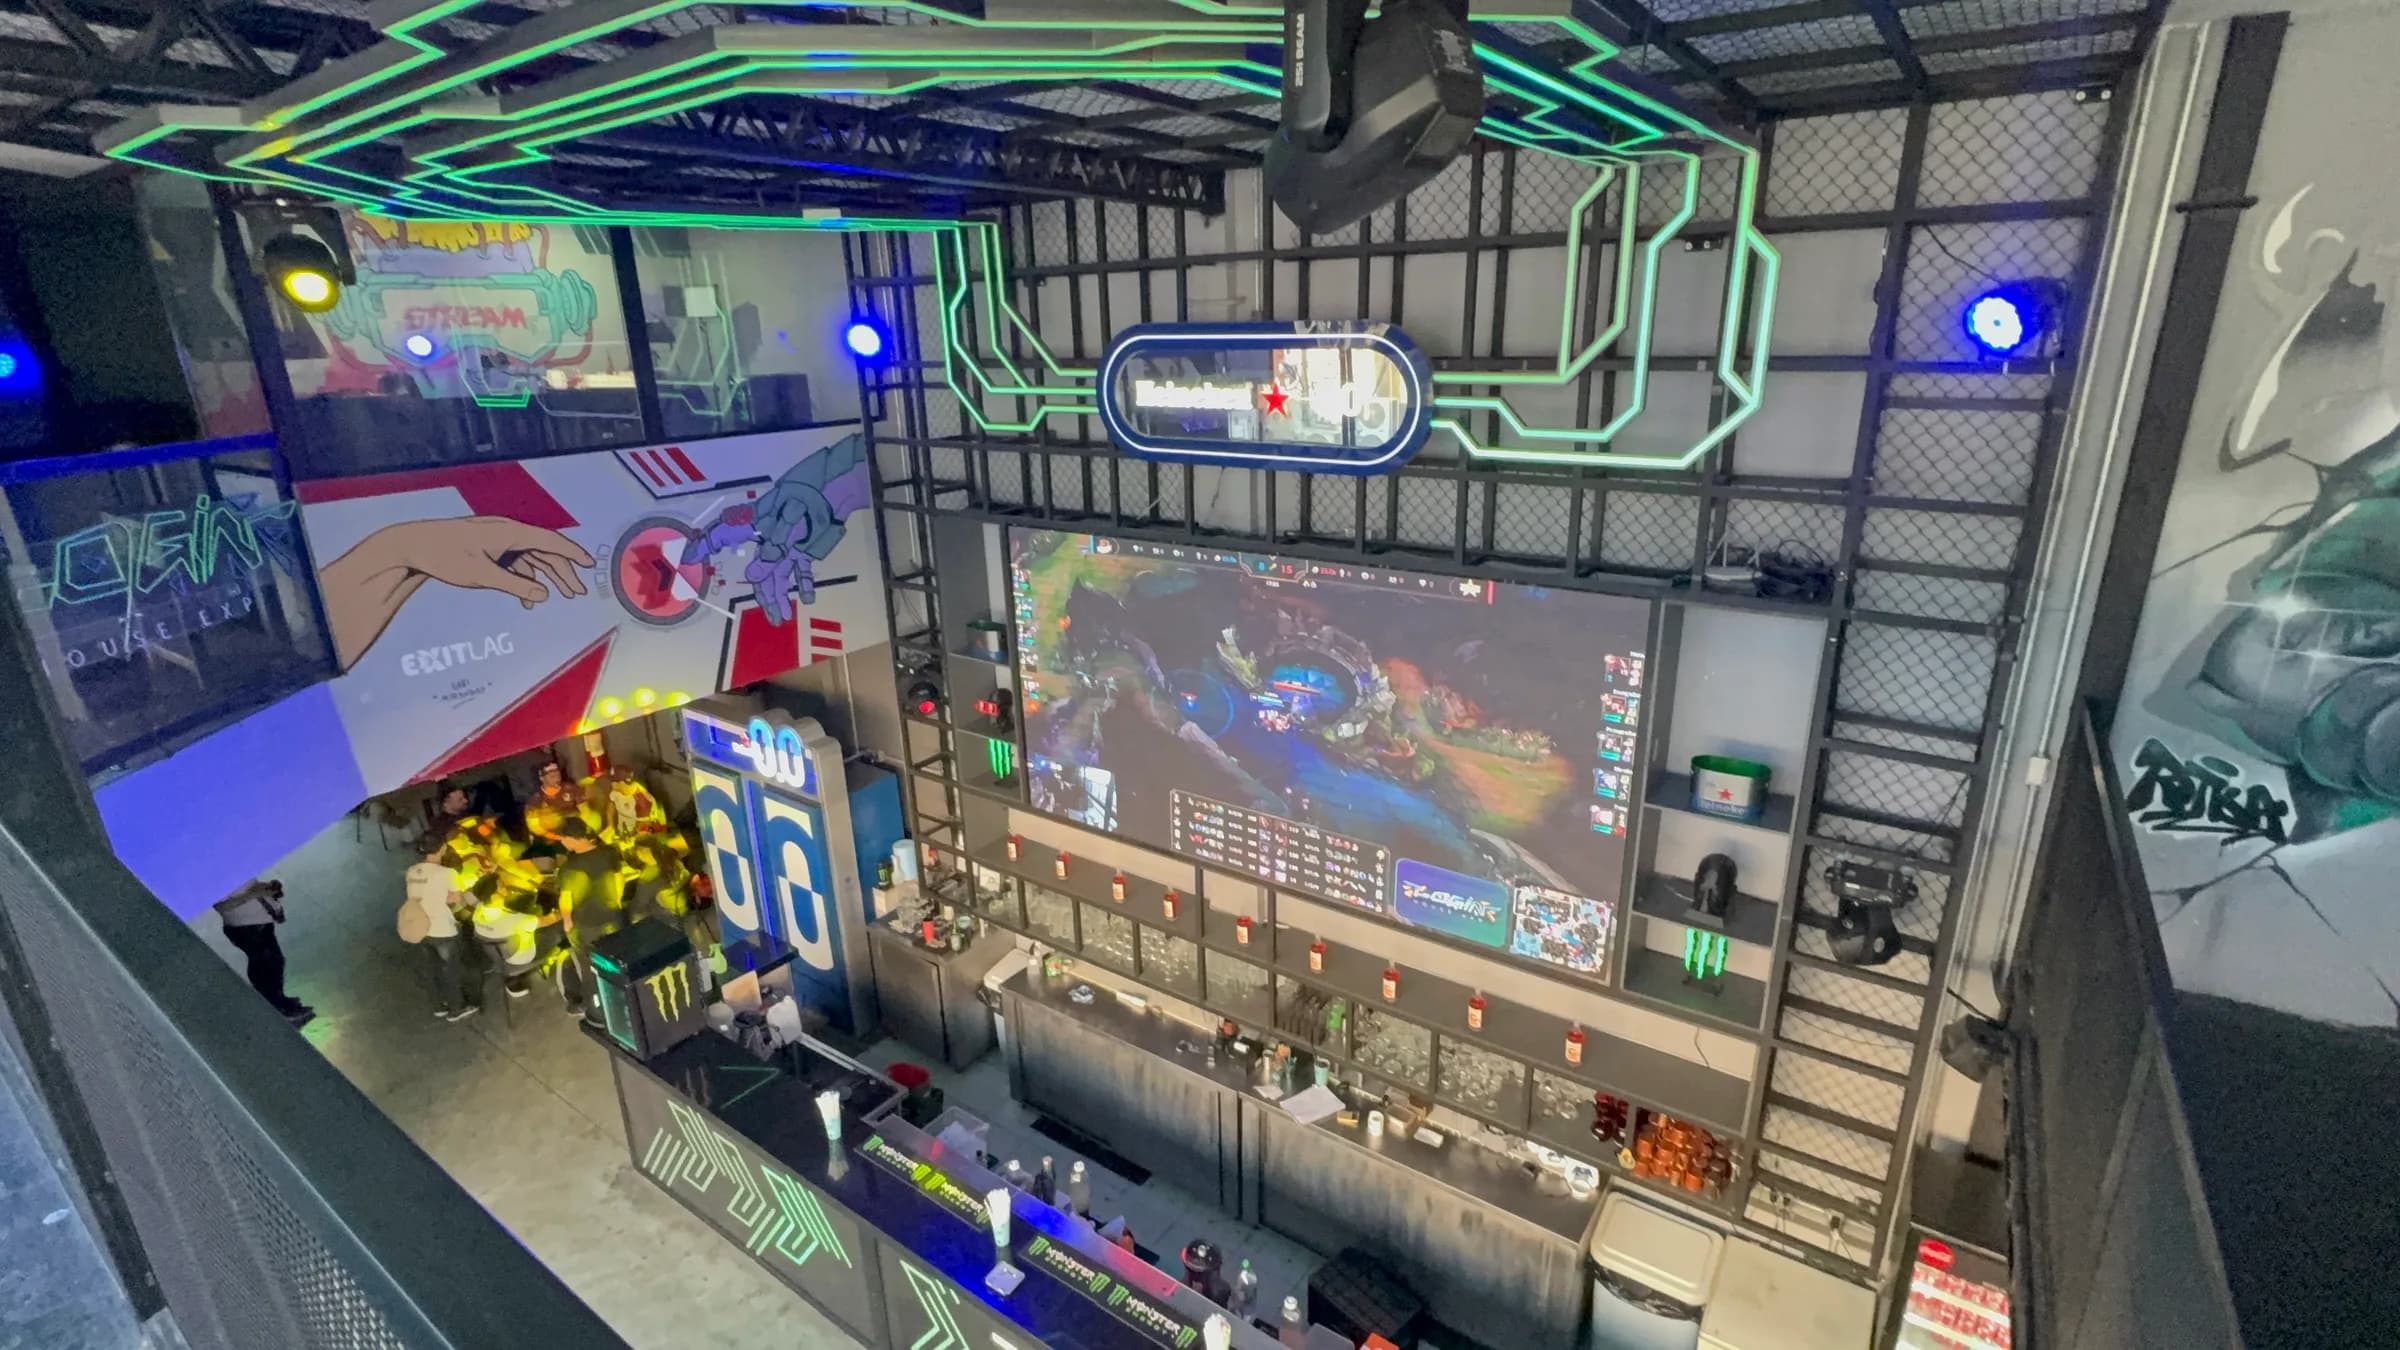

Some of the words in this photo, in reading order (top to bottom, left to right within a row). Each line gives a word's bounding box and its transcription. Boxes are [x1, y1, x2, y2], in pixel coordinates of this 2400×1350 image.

[1296, 13, 1305, 60] BEAM
[401, 632, 515, 676] EXITLAG
[1045, 1246, 1096, 1281] MONSTER
[1125, 1295, 1181, 1335] MONSTER
